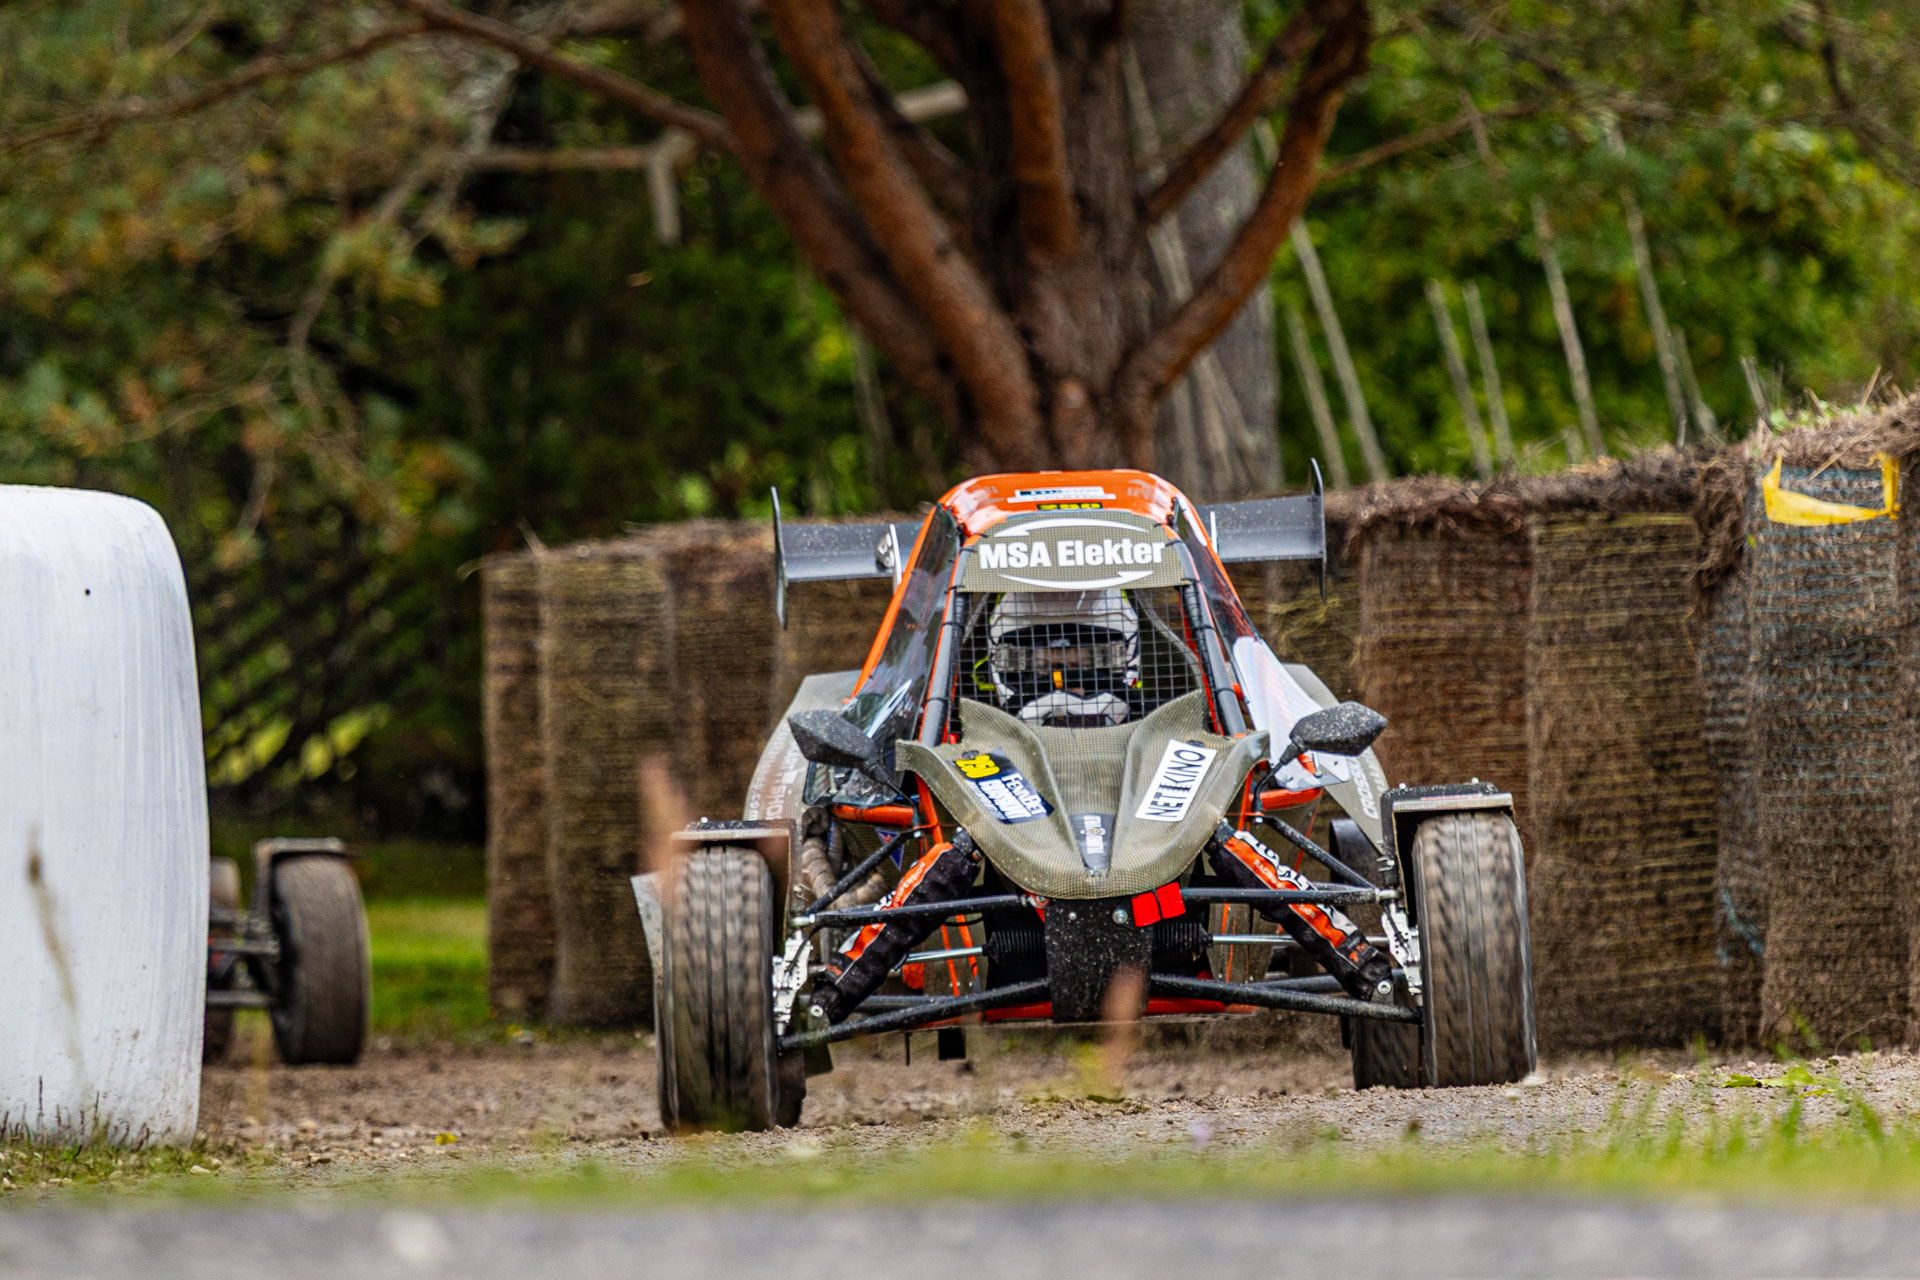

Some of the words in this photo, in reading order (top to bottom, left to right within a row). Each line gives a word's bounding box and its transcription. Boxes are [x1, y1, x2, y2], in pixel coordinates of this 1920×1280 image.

[978, 542, 1052, 569] MSA
[1057, 539, 1165, 566] Elekter
[956, 754, 1000, 778] 250
